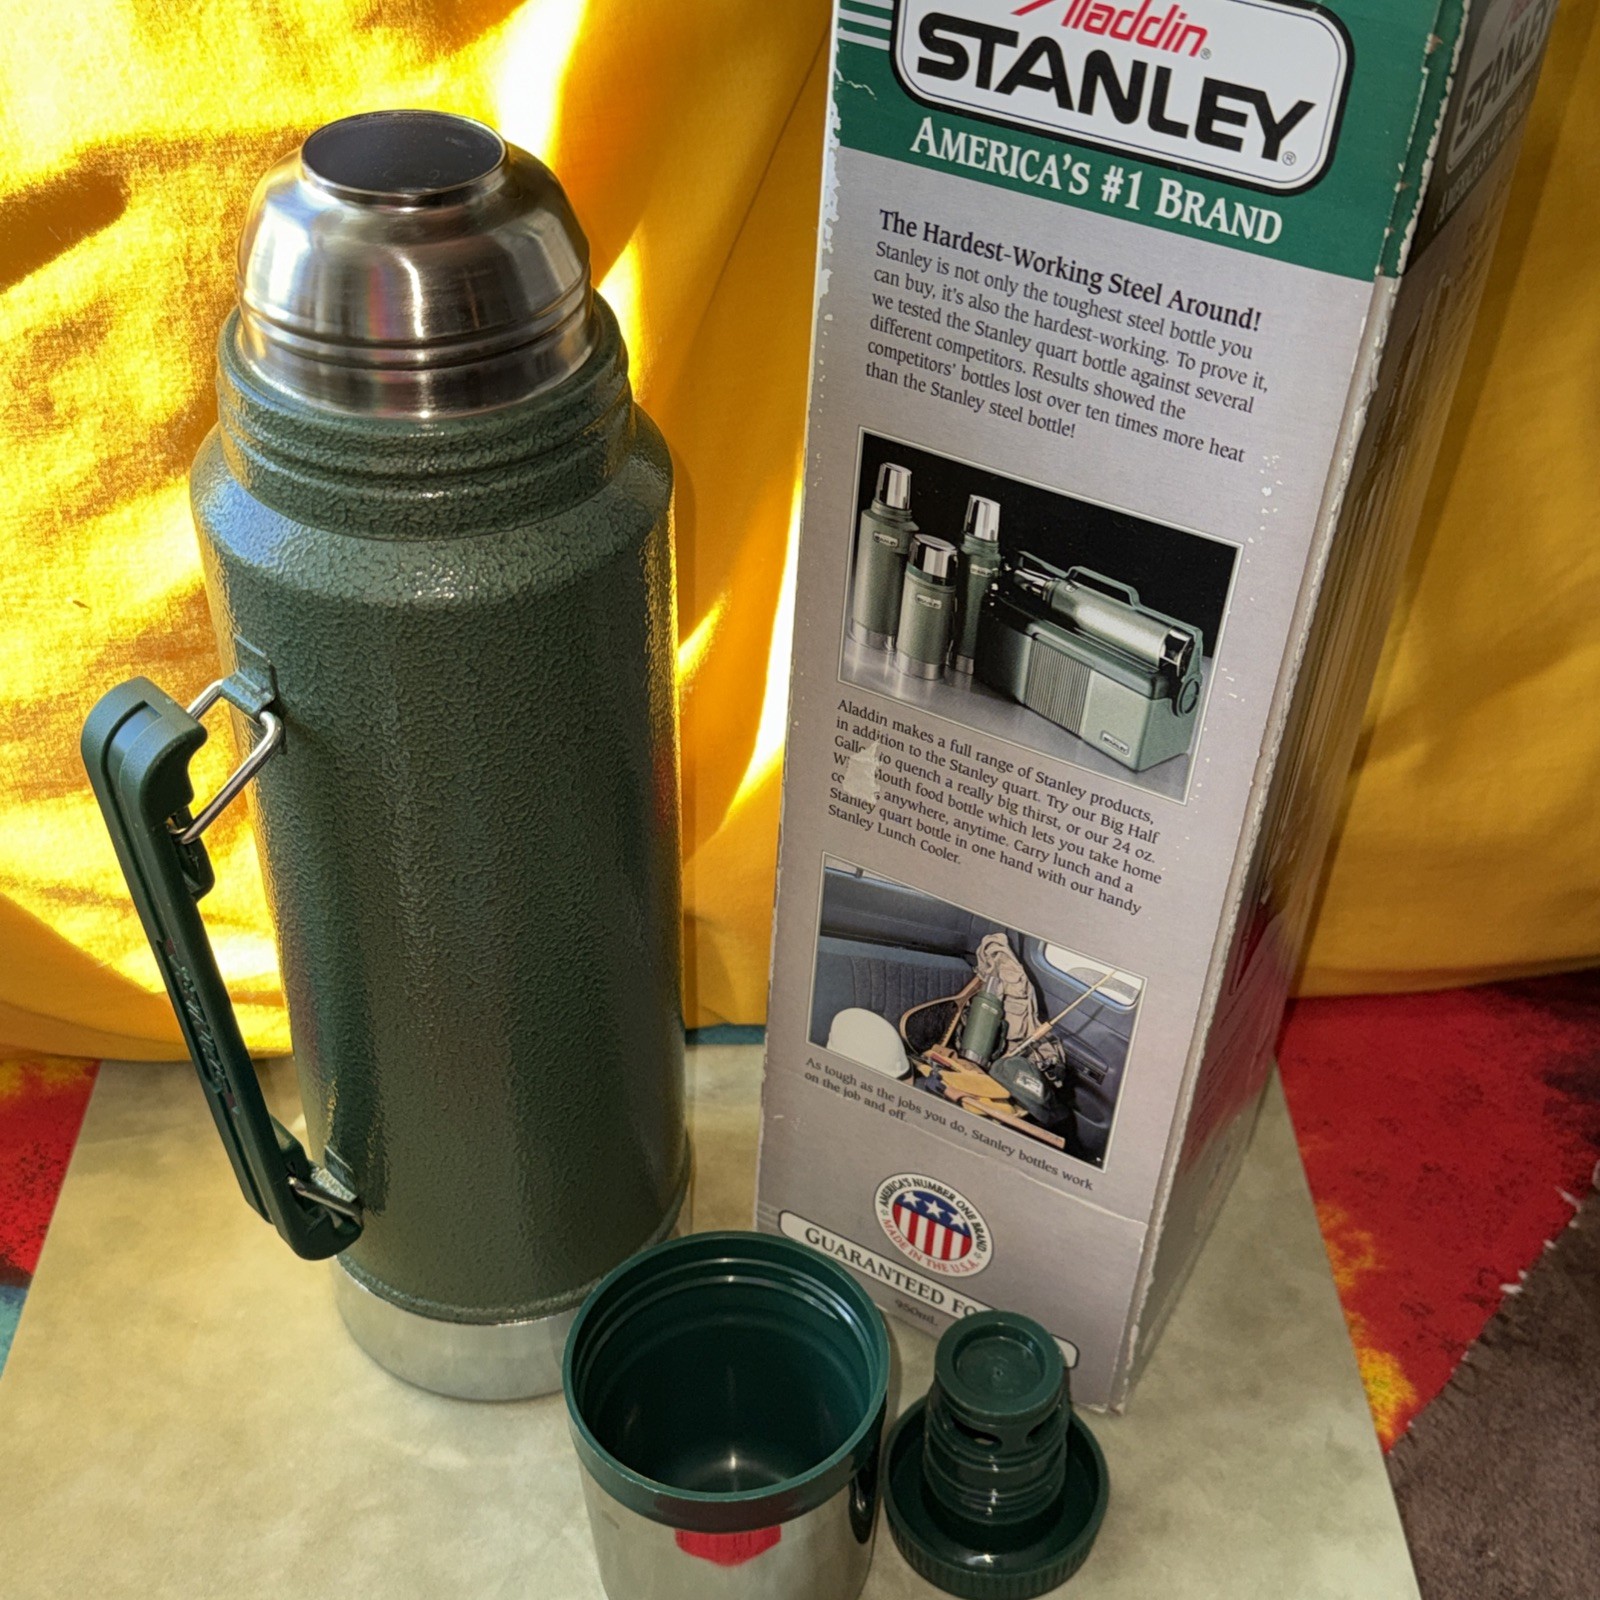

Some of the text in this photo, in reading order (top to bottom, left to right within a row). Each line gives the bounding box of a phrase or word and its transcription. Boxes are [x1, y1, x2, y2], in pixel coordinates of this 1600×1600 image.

[917, 12, 1315, 161] STANLEY
[910, 117, 1282, 244] AMERICA'S #1 BRAND
[875, 240, 1252, 359] Stanley is not only the toughest steel bottle you
[879, 208, 1262, 332] The Hardest-Working Steel Around!
[869, 314, 1186, 420] different competitors. Results showed the
[871, 292, 1254, 413] we tested the Stanley quart bottle against several
[873, 269, 1267, 393] can buy, it's also the hardest-working. To prove it,
[865, 361, 1075, 438] than the Stanley steel bottle!
[867, 341, 1245, 462] competitors' bottles lost over ten times more heat
[836, 718, 1160, 844] in addition to the Stanley quart. Try our Big Half
[837, 699, 1153, 825] Aladdin makes a full range of Stanley products,
[878, 752, 891, 764] to
[894, 759, 940, 783] quench
[944, 778, 952, 788] a
[957, 782, 993, 804] really
[997, 793, 1018, 815] big
[1022, 804, 1060, 830] thirst,
[1065, 823, 1081, 835] or
[1084, 830, 1108, 845] our
[1111, 837, 1130, 854] 24
[1134, 848, 1154, 863] oz.
[828, 804, 960, 864] Stanley Lunch Cooler.
[878, 808, 911, 827] quart
[916, 818, 951, 842] bottle
[954, 836, 967, 849] in
[971, 843, 995, 859] one
[999, 850, 1033, 874] hand
[1037, 867, 1066, 886] with
[1070, 881, 1094, 896] our
[1097, 887, 1141, 915] handy
[884, 791, 1133, 893] anywhere, anytime. Carry lunch and a
[915, 782, 943, 803] food
[947, 793, 983, 818] bottle
[988, 812, 1027, 835] which
[1031, 825, 1054, 844] lets
[1057, 838, 1084, 856] you
[1088, 848, 1118, 868] take
[1122, 859, 1161, 884] home
[804, 1072, 819, 1083] on
[822, 1078, 840, 1092] the
[842, 1086, 861, 1101] job
[863, 1097, 885, 1112] and
[806, 1057, 1092, 1190] As tough as the jobs you do, Stanley bottles work
[805, 1226, 945, 1305] GUARANTEED
[879, 1177, 987, 1252] AMERICA'S NUMBER ONE BRAND
[882, 1218, 909, 1249] MADE
[908, 1248, 923, 1262] IN
[926, 1258, 949, 1272] THE
